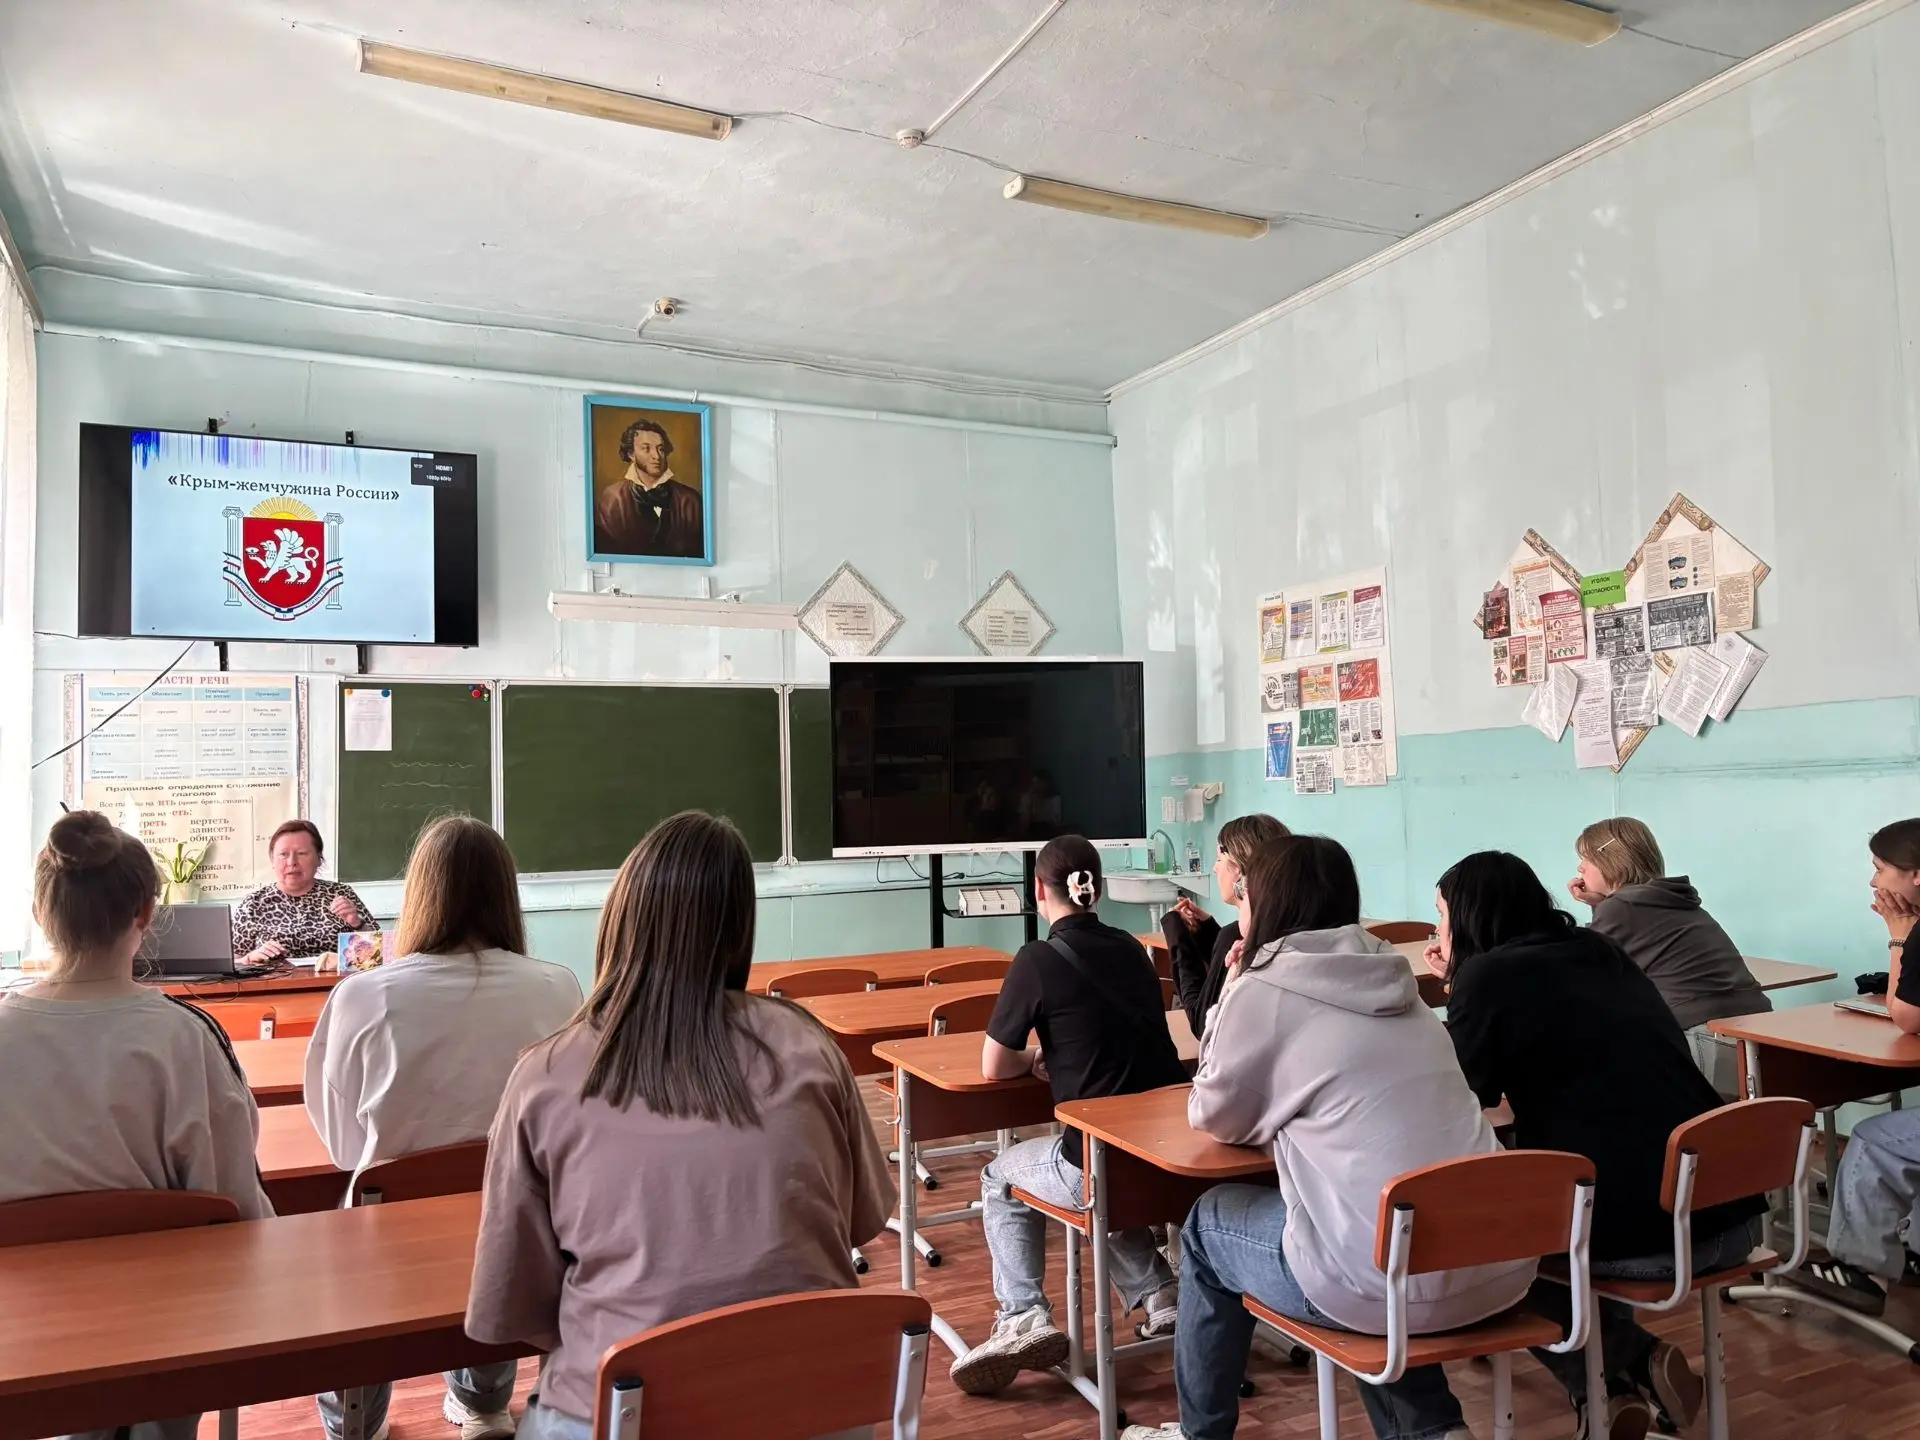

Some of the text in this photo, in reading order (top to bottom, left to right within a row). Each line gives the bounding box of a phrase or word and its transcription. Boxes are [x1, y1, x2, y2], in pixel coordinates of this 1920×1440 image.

[167, 473, 400, 501] «Крым-жемчужина России»
[200, 676, 230, 685] РЕЧИ
[105, 784, 164, 793] Правильно
[190, 818, 230, 827] вертеть
[189, 826, 235, 834] зависеть
